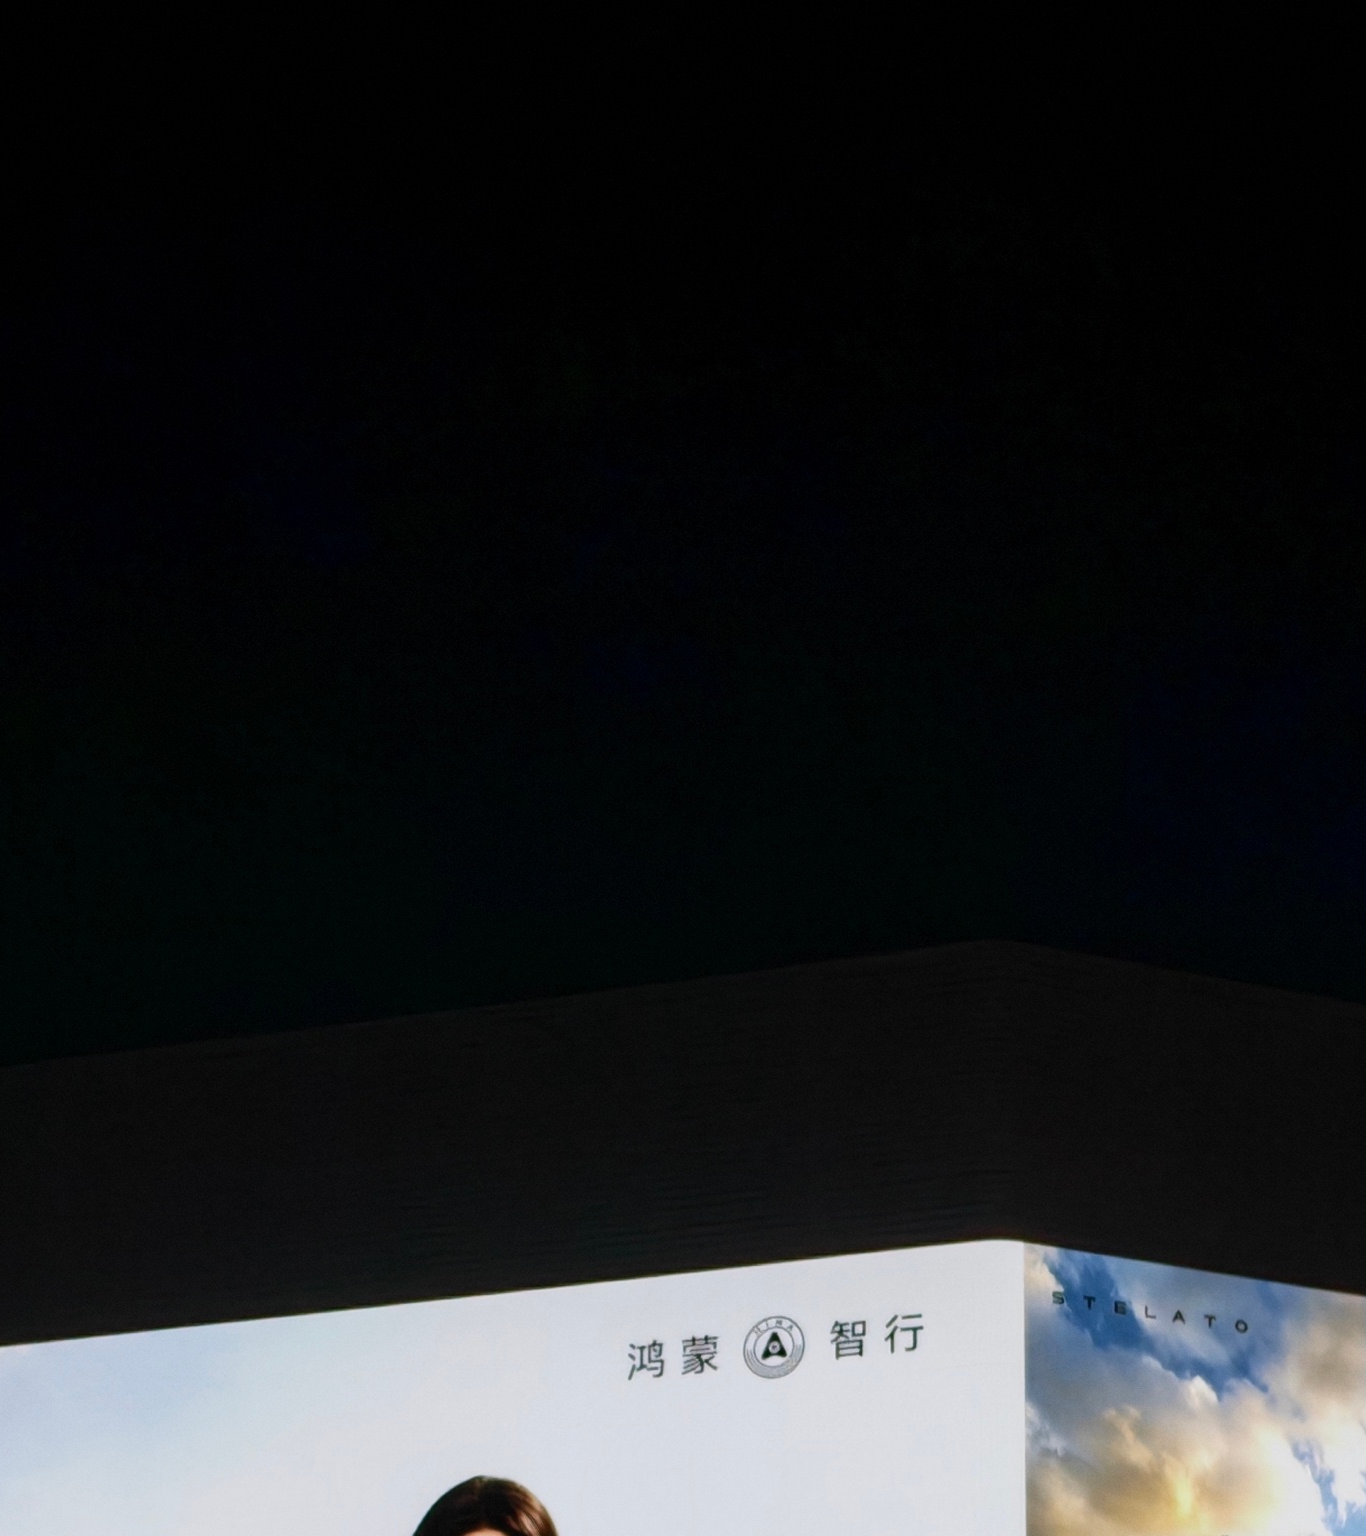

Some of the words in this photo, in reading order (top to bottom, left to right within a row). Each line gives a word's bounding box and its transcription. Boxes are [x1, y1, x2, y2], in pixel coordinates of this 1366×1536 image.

[1052, 1291, 1249, 1334] STELATO
[627, 1334, 720, 1381] 鸿蒙
[830, 1313, 925, 1360] 智行
